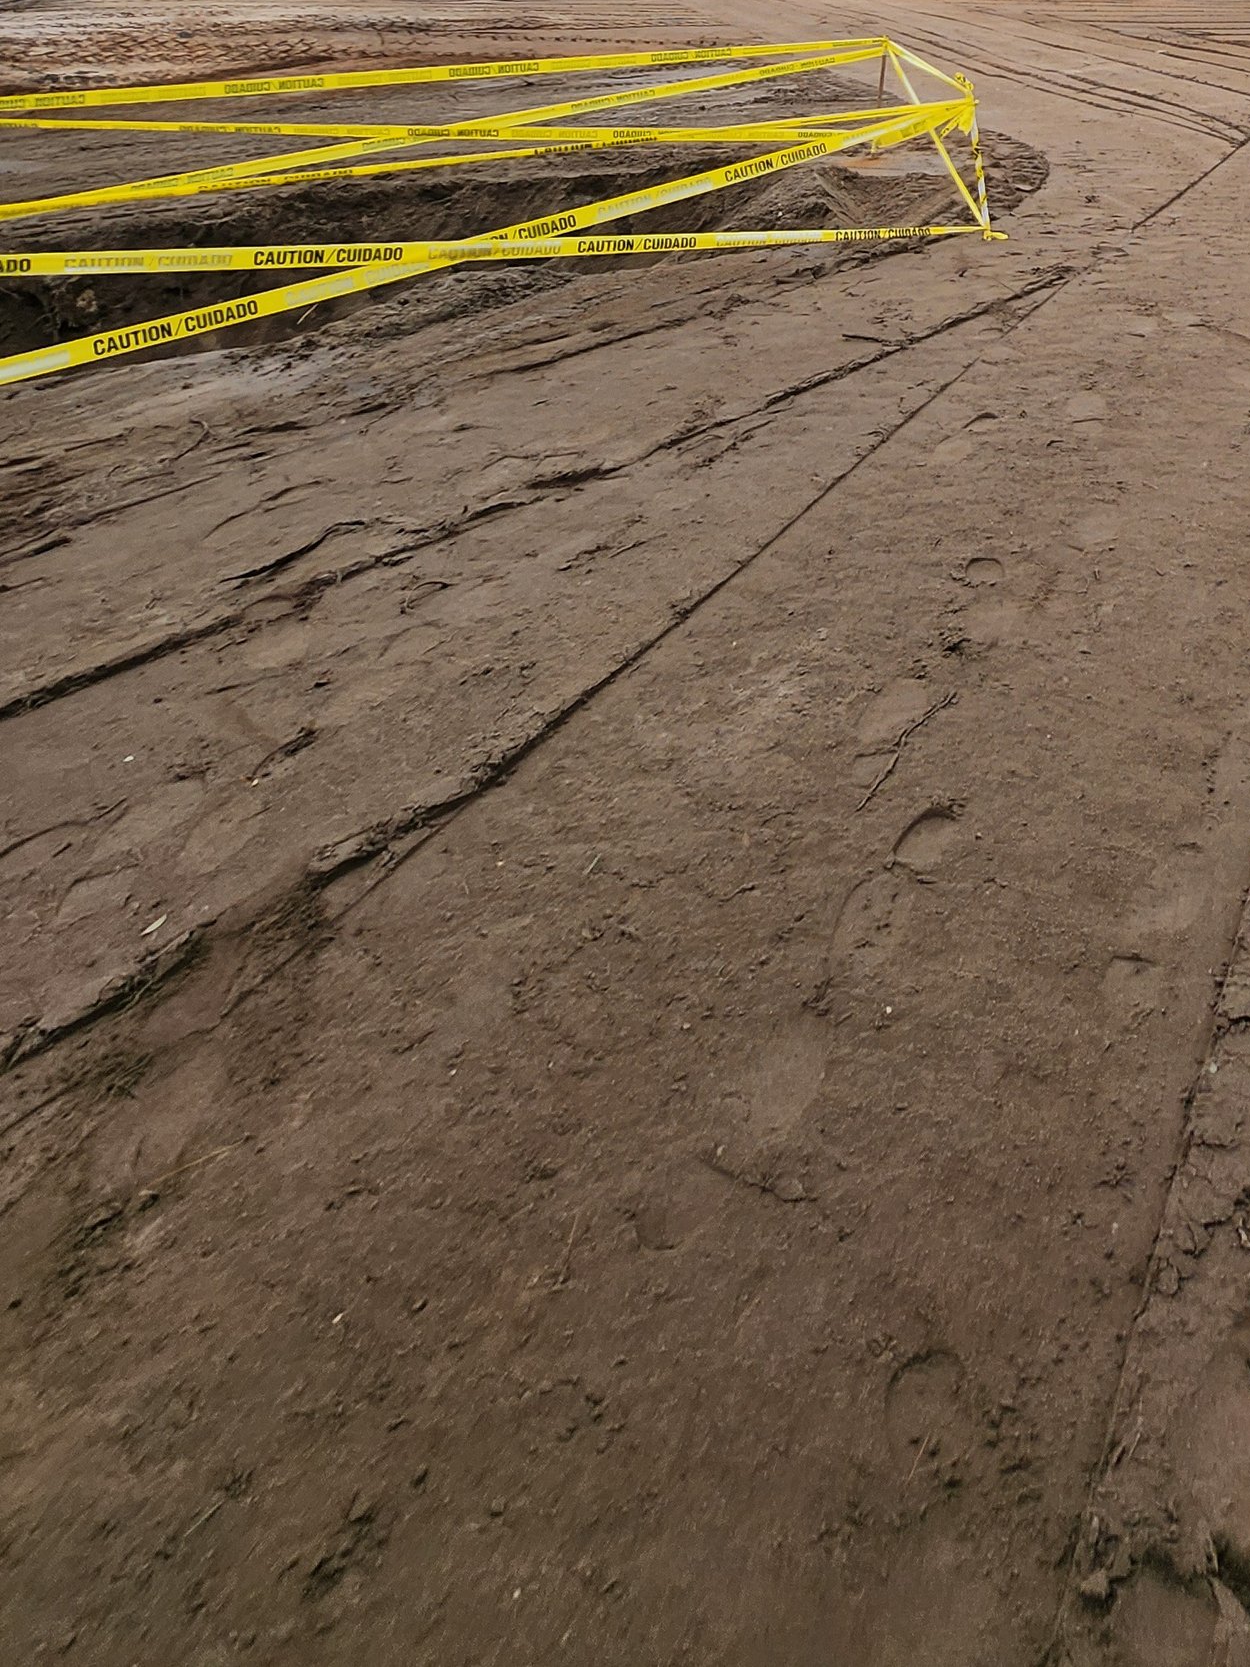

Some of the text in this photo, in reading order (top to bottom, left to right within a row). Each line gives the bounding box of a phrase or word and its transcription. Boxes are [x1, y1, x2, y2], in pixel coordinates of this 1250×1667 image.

[577, 237, 697, 253] CAUTION/CUIDADO
[254, 247, 403, 265] CAUTION/CUIDADO
[93, 299, 259, 356] CAUTION/CUIDADO
